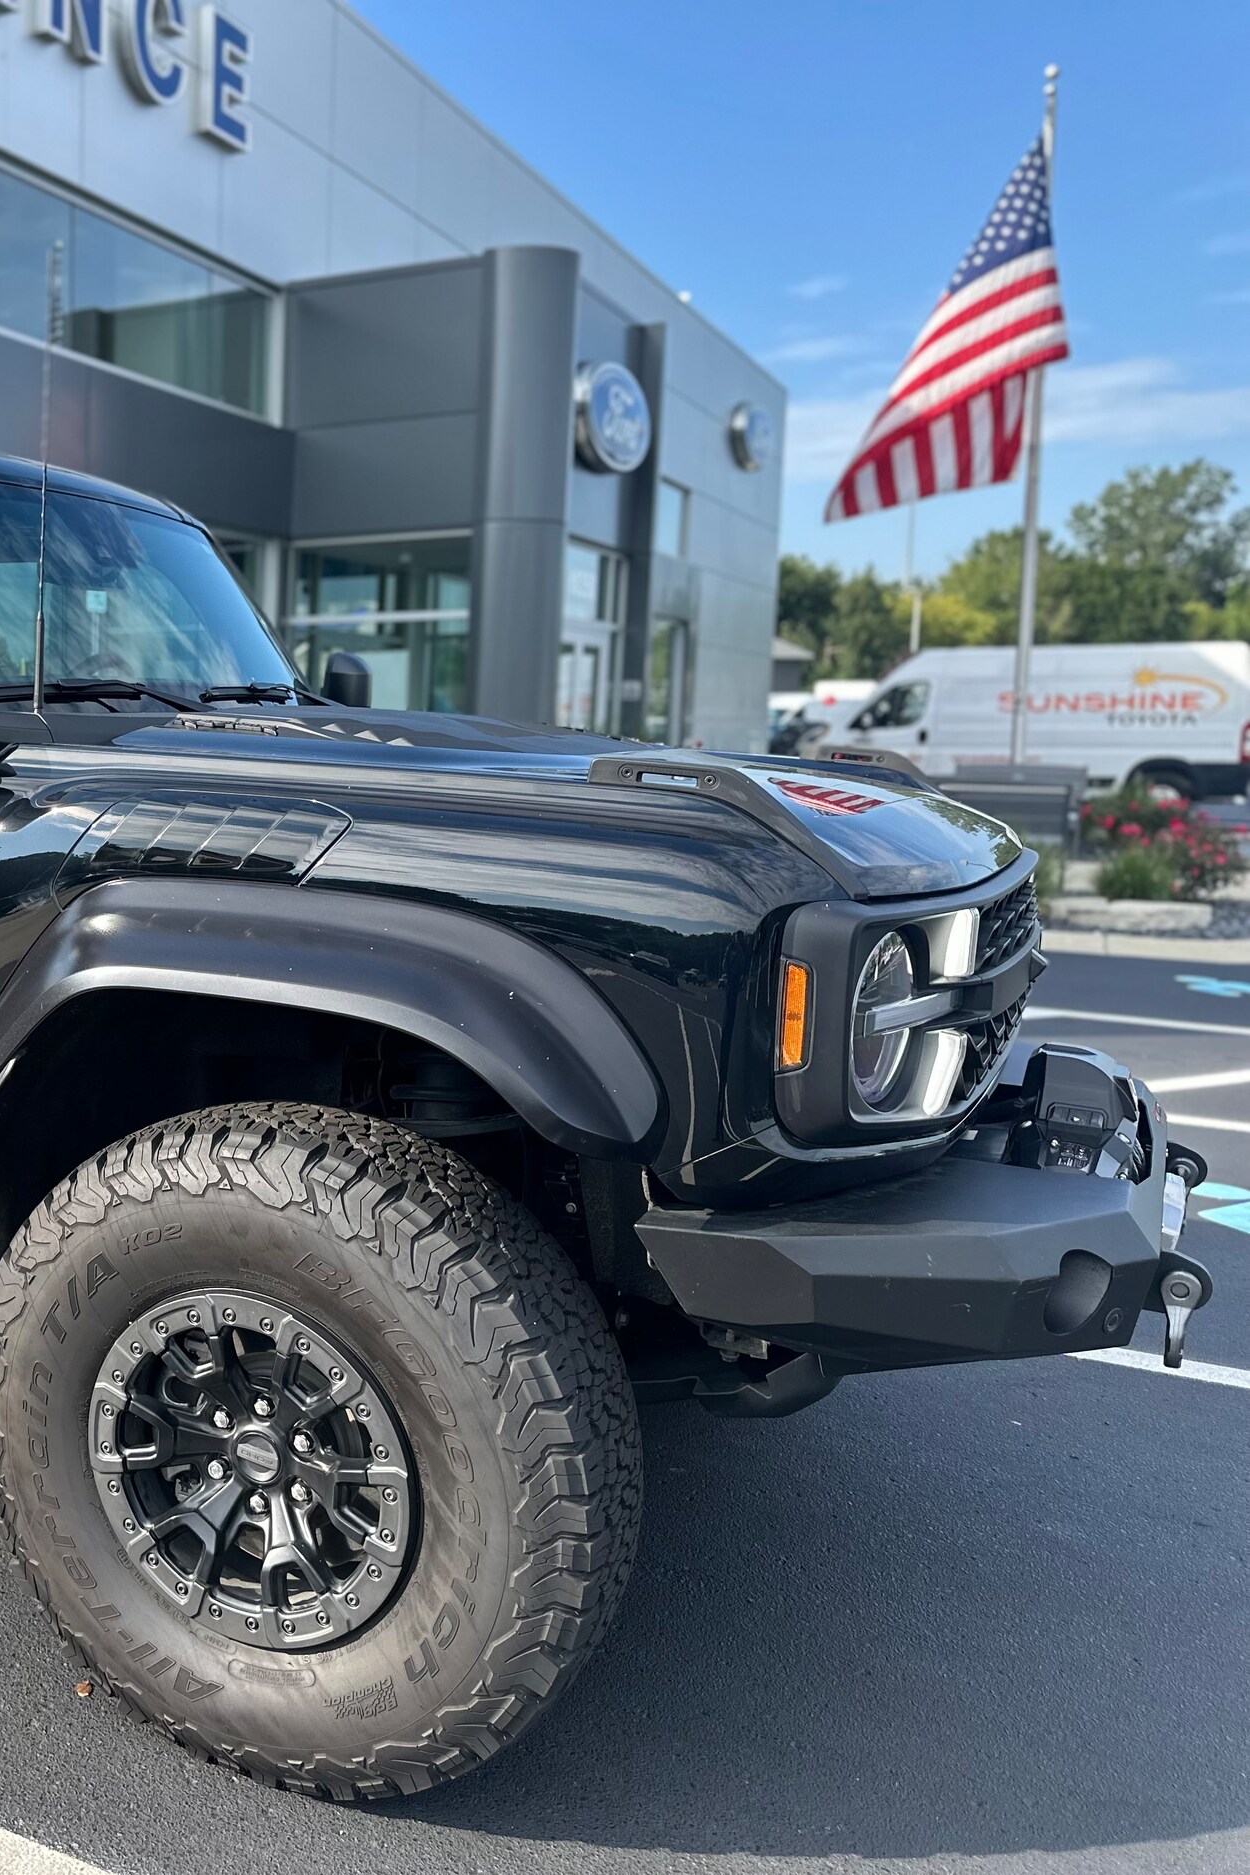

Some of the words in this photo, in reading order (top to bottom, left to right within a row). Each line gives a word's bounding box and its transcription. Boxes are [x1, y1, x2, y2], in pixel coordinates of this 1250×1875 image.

[997, 691, 1203, 713] SUNSHINE
[1106, 714, 1198, 727] TOYOTA
[121, 1222, 183, 1256] KO2
[40, 1251, 120, 1344] T/A
[22, 1360, 224, 1702] All-Terrain
[321, 1675, 393, 1708] Champion
